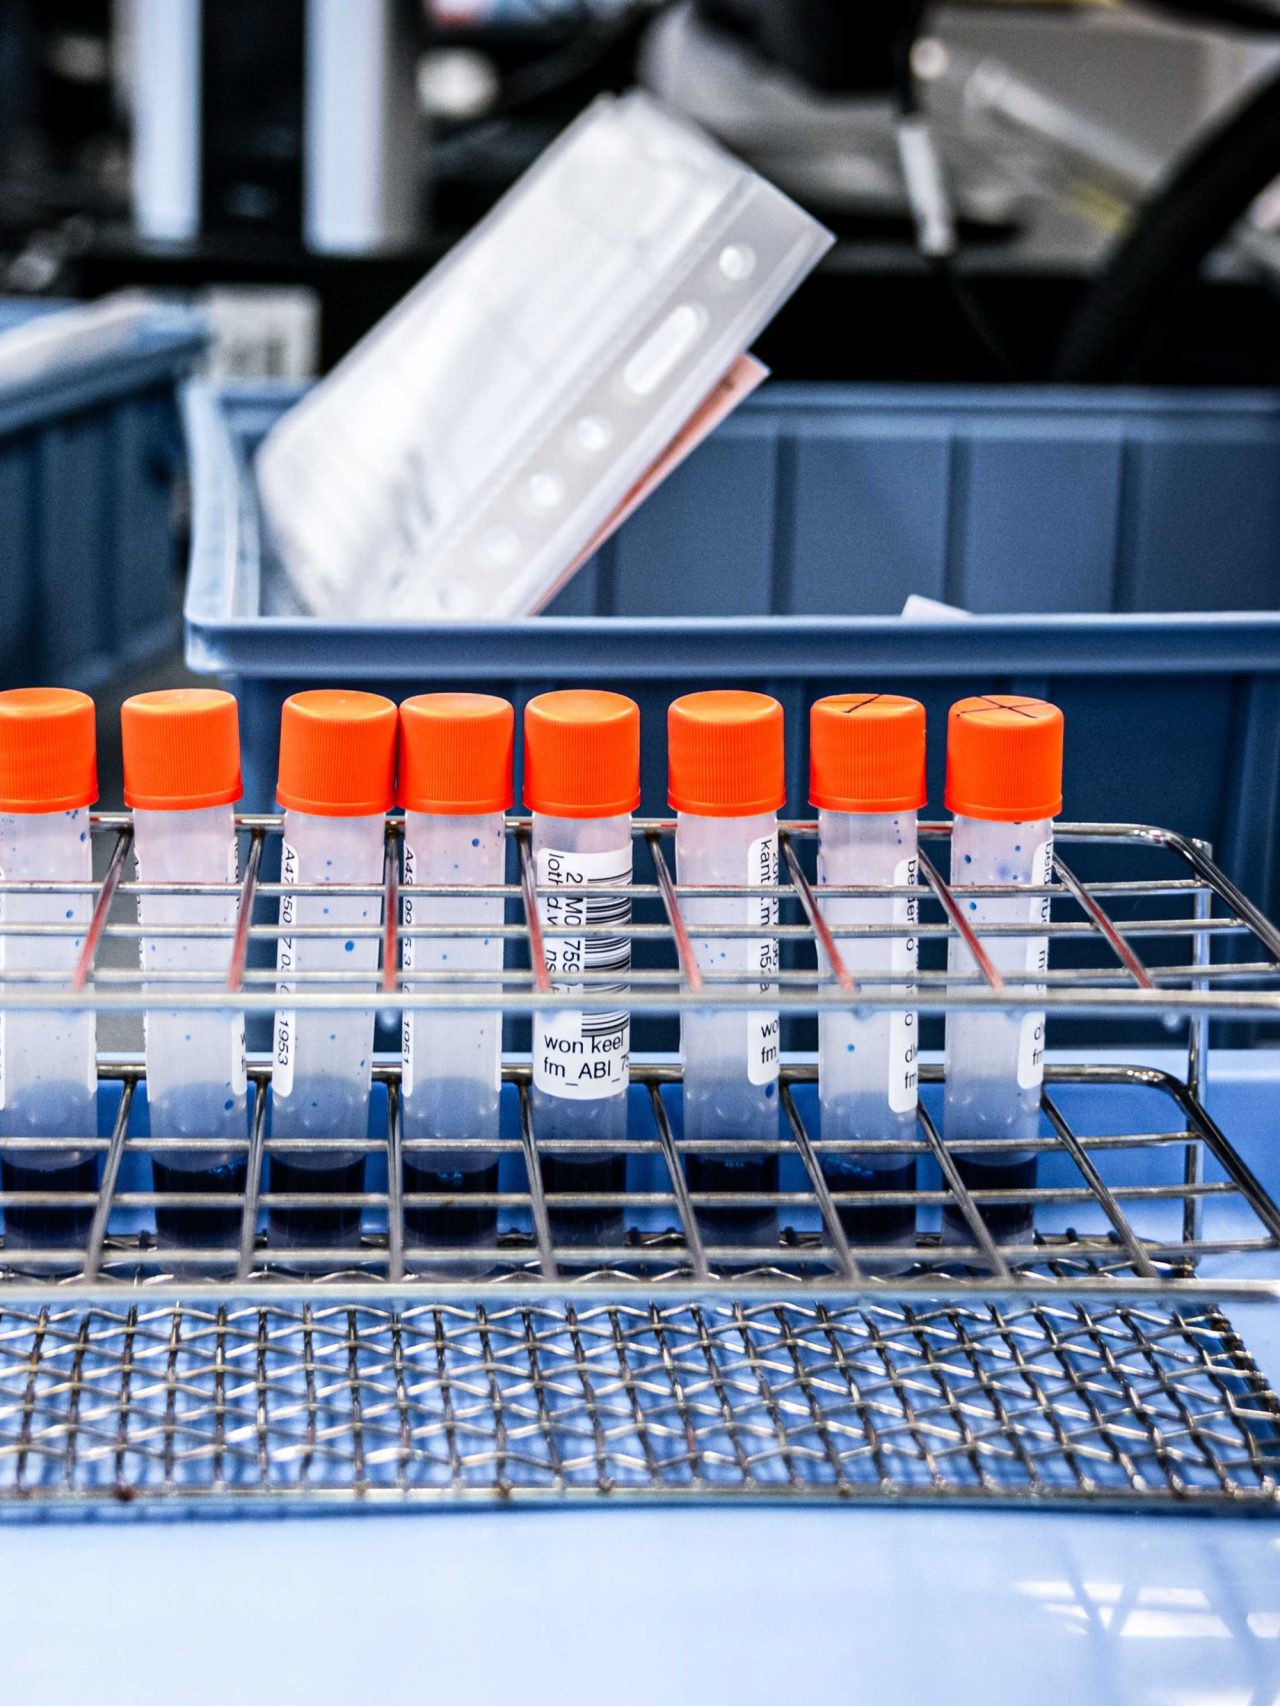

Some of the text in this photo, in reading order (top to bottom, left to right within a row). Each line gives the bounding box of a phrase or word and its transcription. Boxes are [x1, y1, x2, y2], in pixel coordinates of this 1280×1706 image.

[543, 1030, 624, 1054] won keel
[543, 1054, 630, 1087] fm_ABI_7
